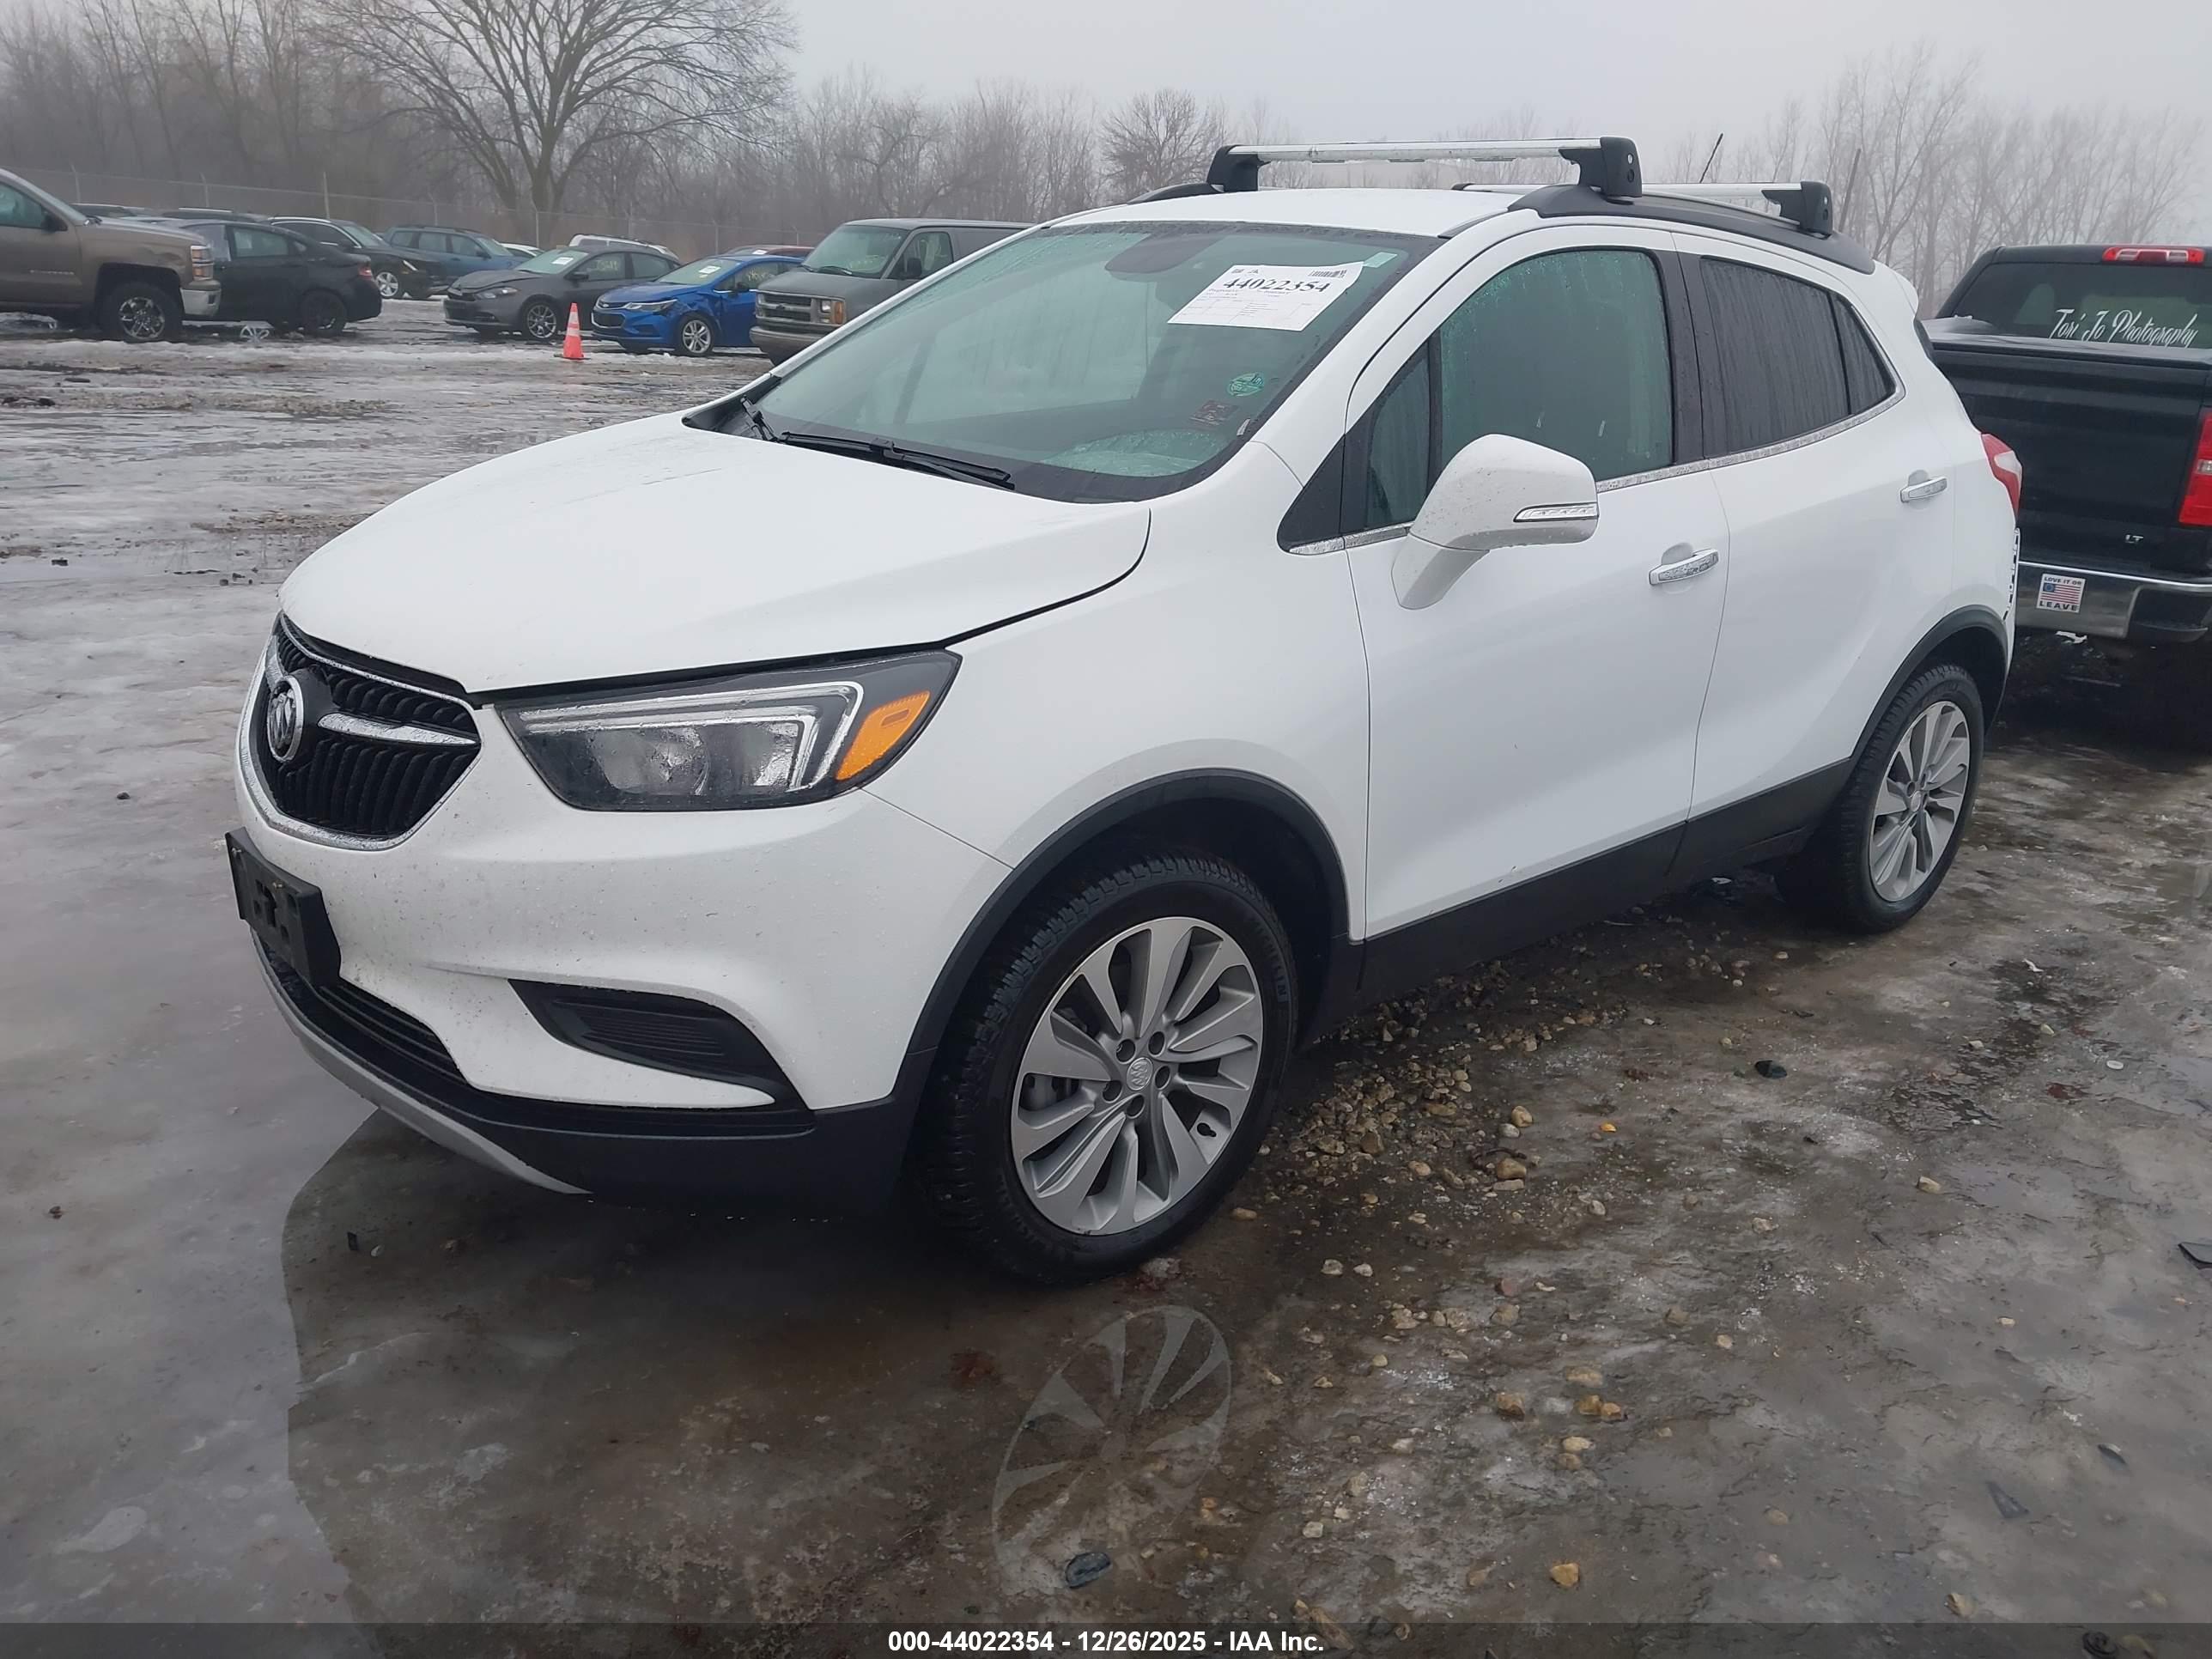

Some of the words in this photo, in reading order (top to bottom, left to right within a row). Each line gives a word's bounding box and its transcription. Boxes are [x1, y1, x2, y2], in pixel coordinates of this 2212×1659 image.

[1224, 277, 1331, 292] 44022354
[2050, 308, 2086, 340] Tori
[2081, 310, 2110, 342] Jo
[2107, 309, 2199, 349] Photography
[2124, 533, 2144, 544] LT
[2039, 600, 2078, 611] LEAVE
